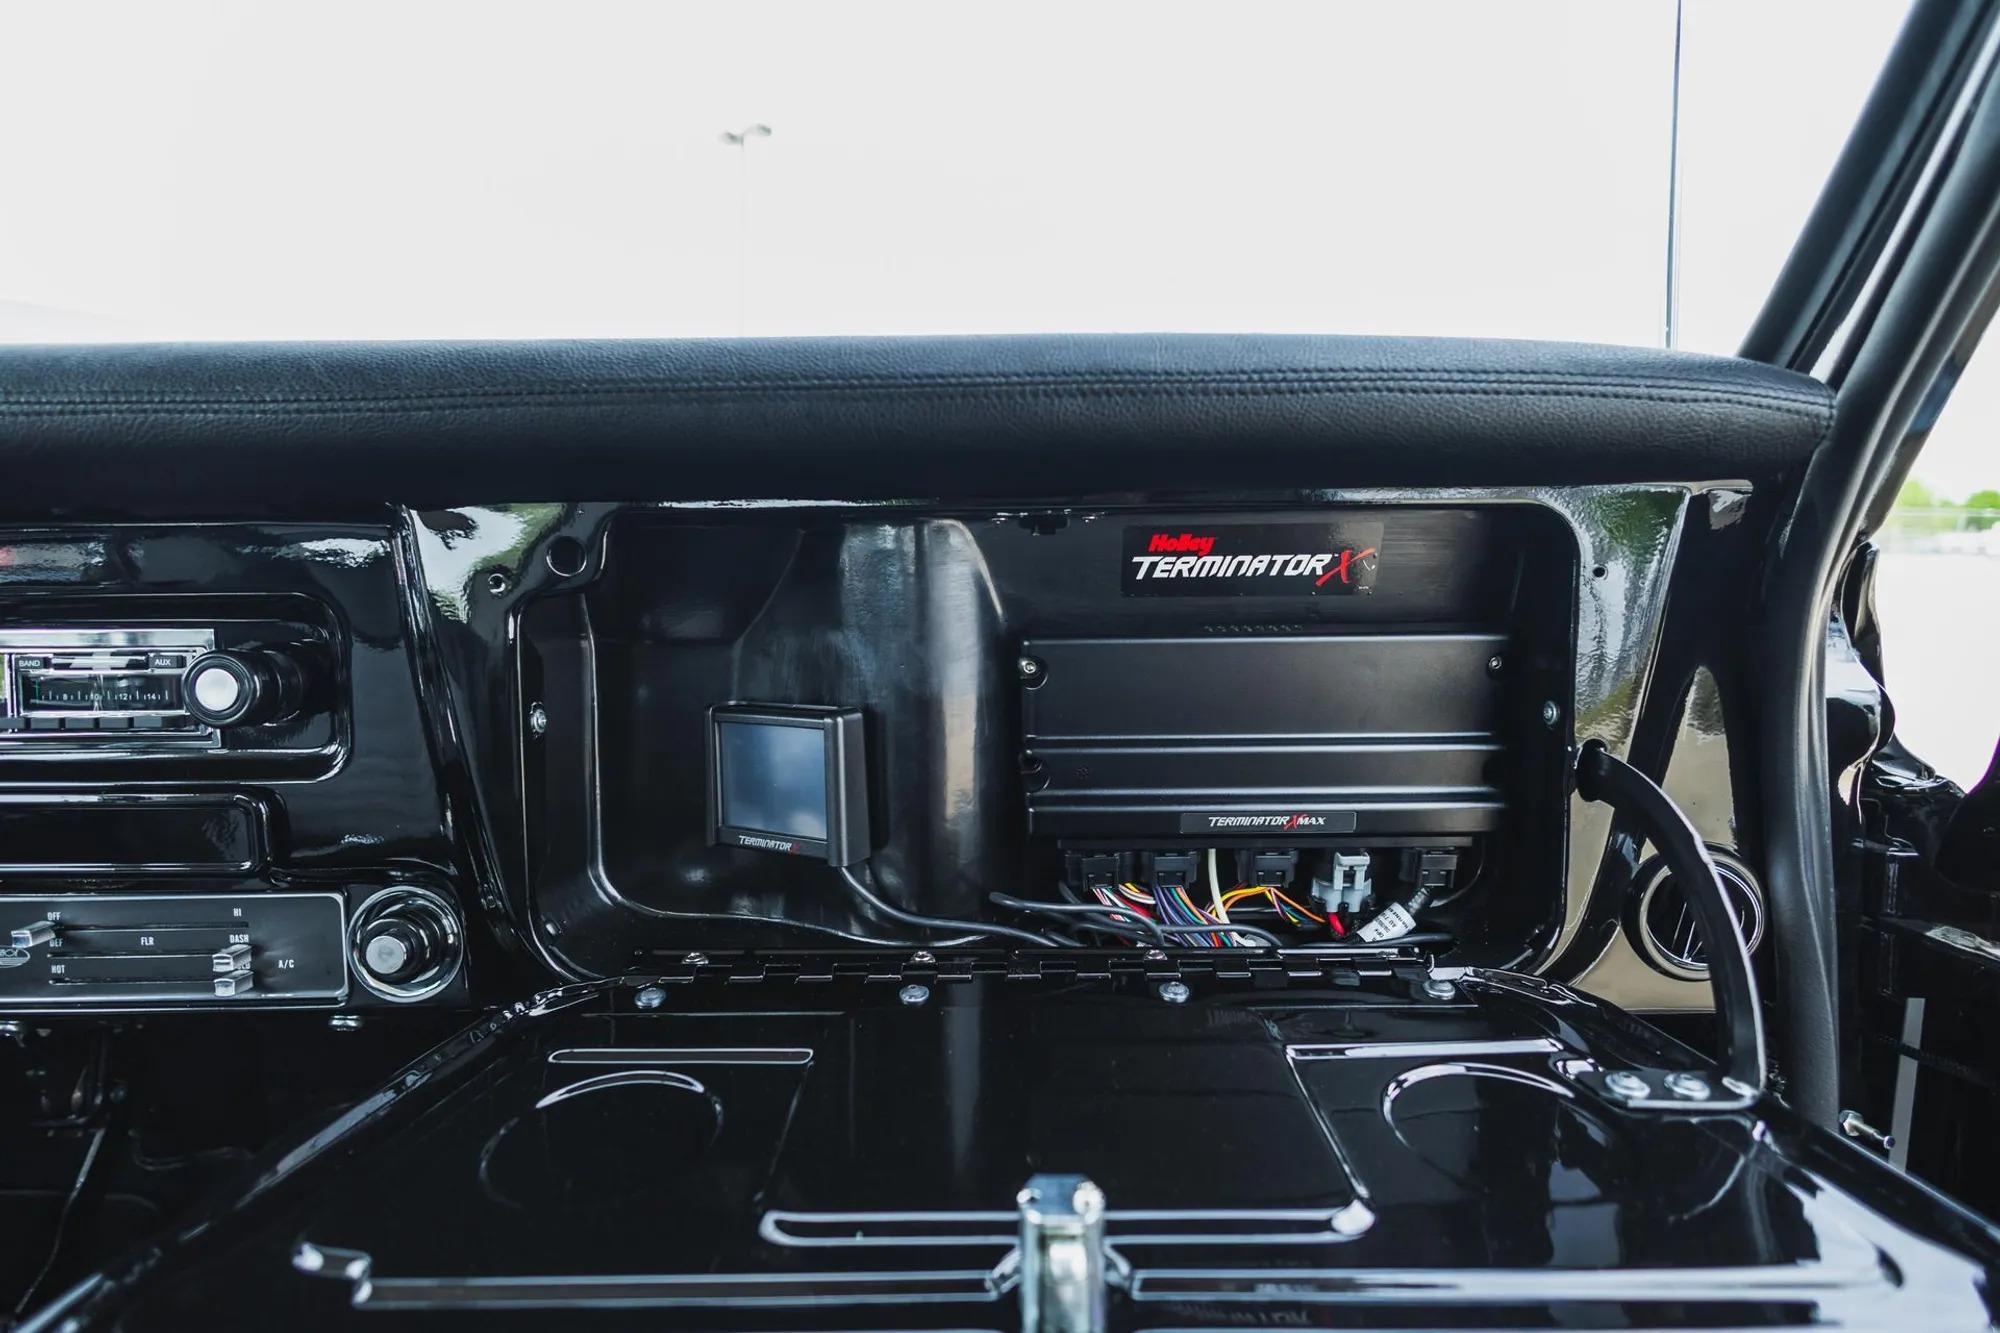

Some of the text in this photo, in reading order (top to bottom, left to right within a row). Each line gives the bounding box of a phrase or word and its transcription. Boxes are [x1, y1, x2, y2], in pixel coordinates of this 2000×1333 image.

[1148, 534, 1216, 556] Holley
[18, 659, 41, 667] BAND
[154, 658, 171, 666] AUX
[47, 911, 61, 921] OFF
[233, 907, 242, 917] HI
[49, 938, 63, 948] DEF
[140, 936, 155, 946] FLR
[229, 934, 249, 944] DASH
[51, 964, 65, 974] HOT
[278, 959, 295, 969] A/C
